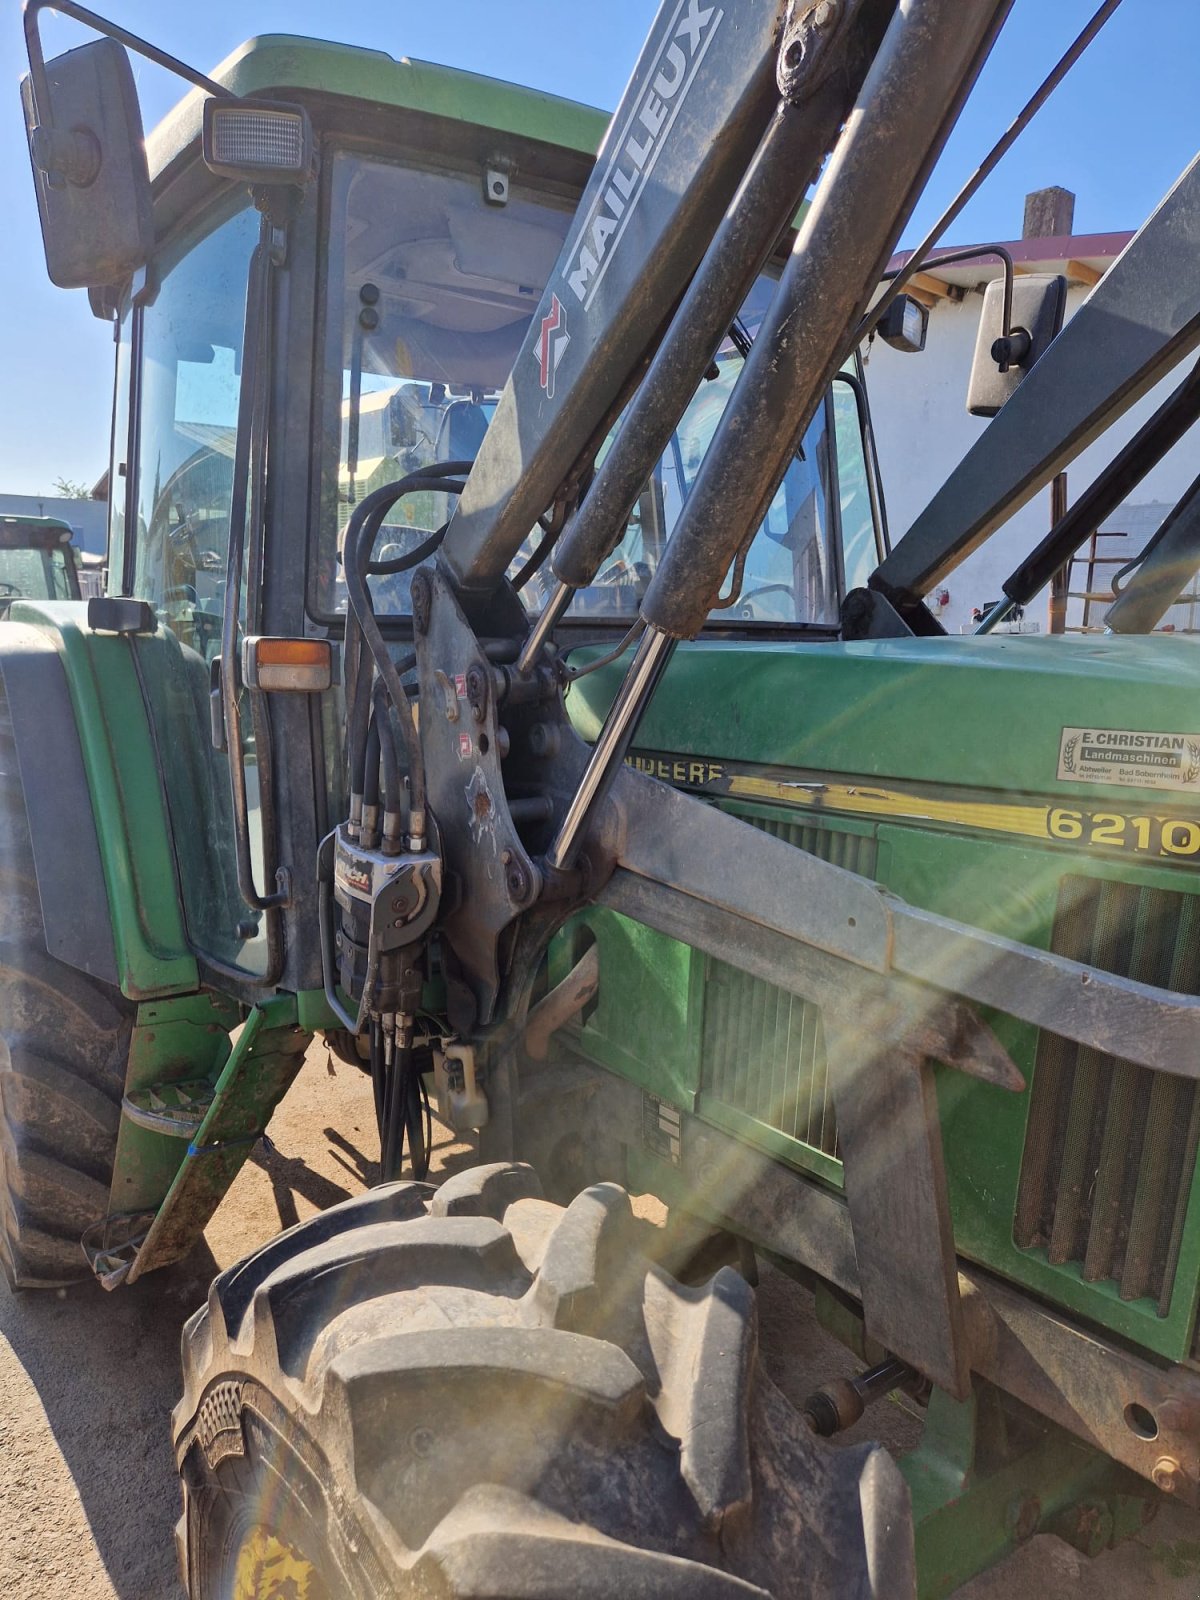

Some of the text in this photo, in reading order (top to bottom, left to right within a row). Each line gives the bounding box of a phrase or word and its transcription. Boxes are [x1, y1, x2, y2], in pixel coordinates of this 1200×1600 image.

[568, 0, 715, 302] MAILLEUX
[1096, 733, 1185, 749] CHRISTIAN
[1085, 749, 1177, 765] Landmaschinen
[1119, 768, 1134, 776] Bad
[1050, 808, 1200, 855] 6210
